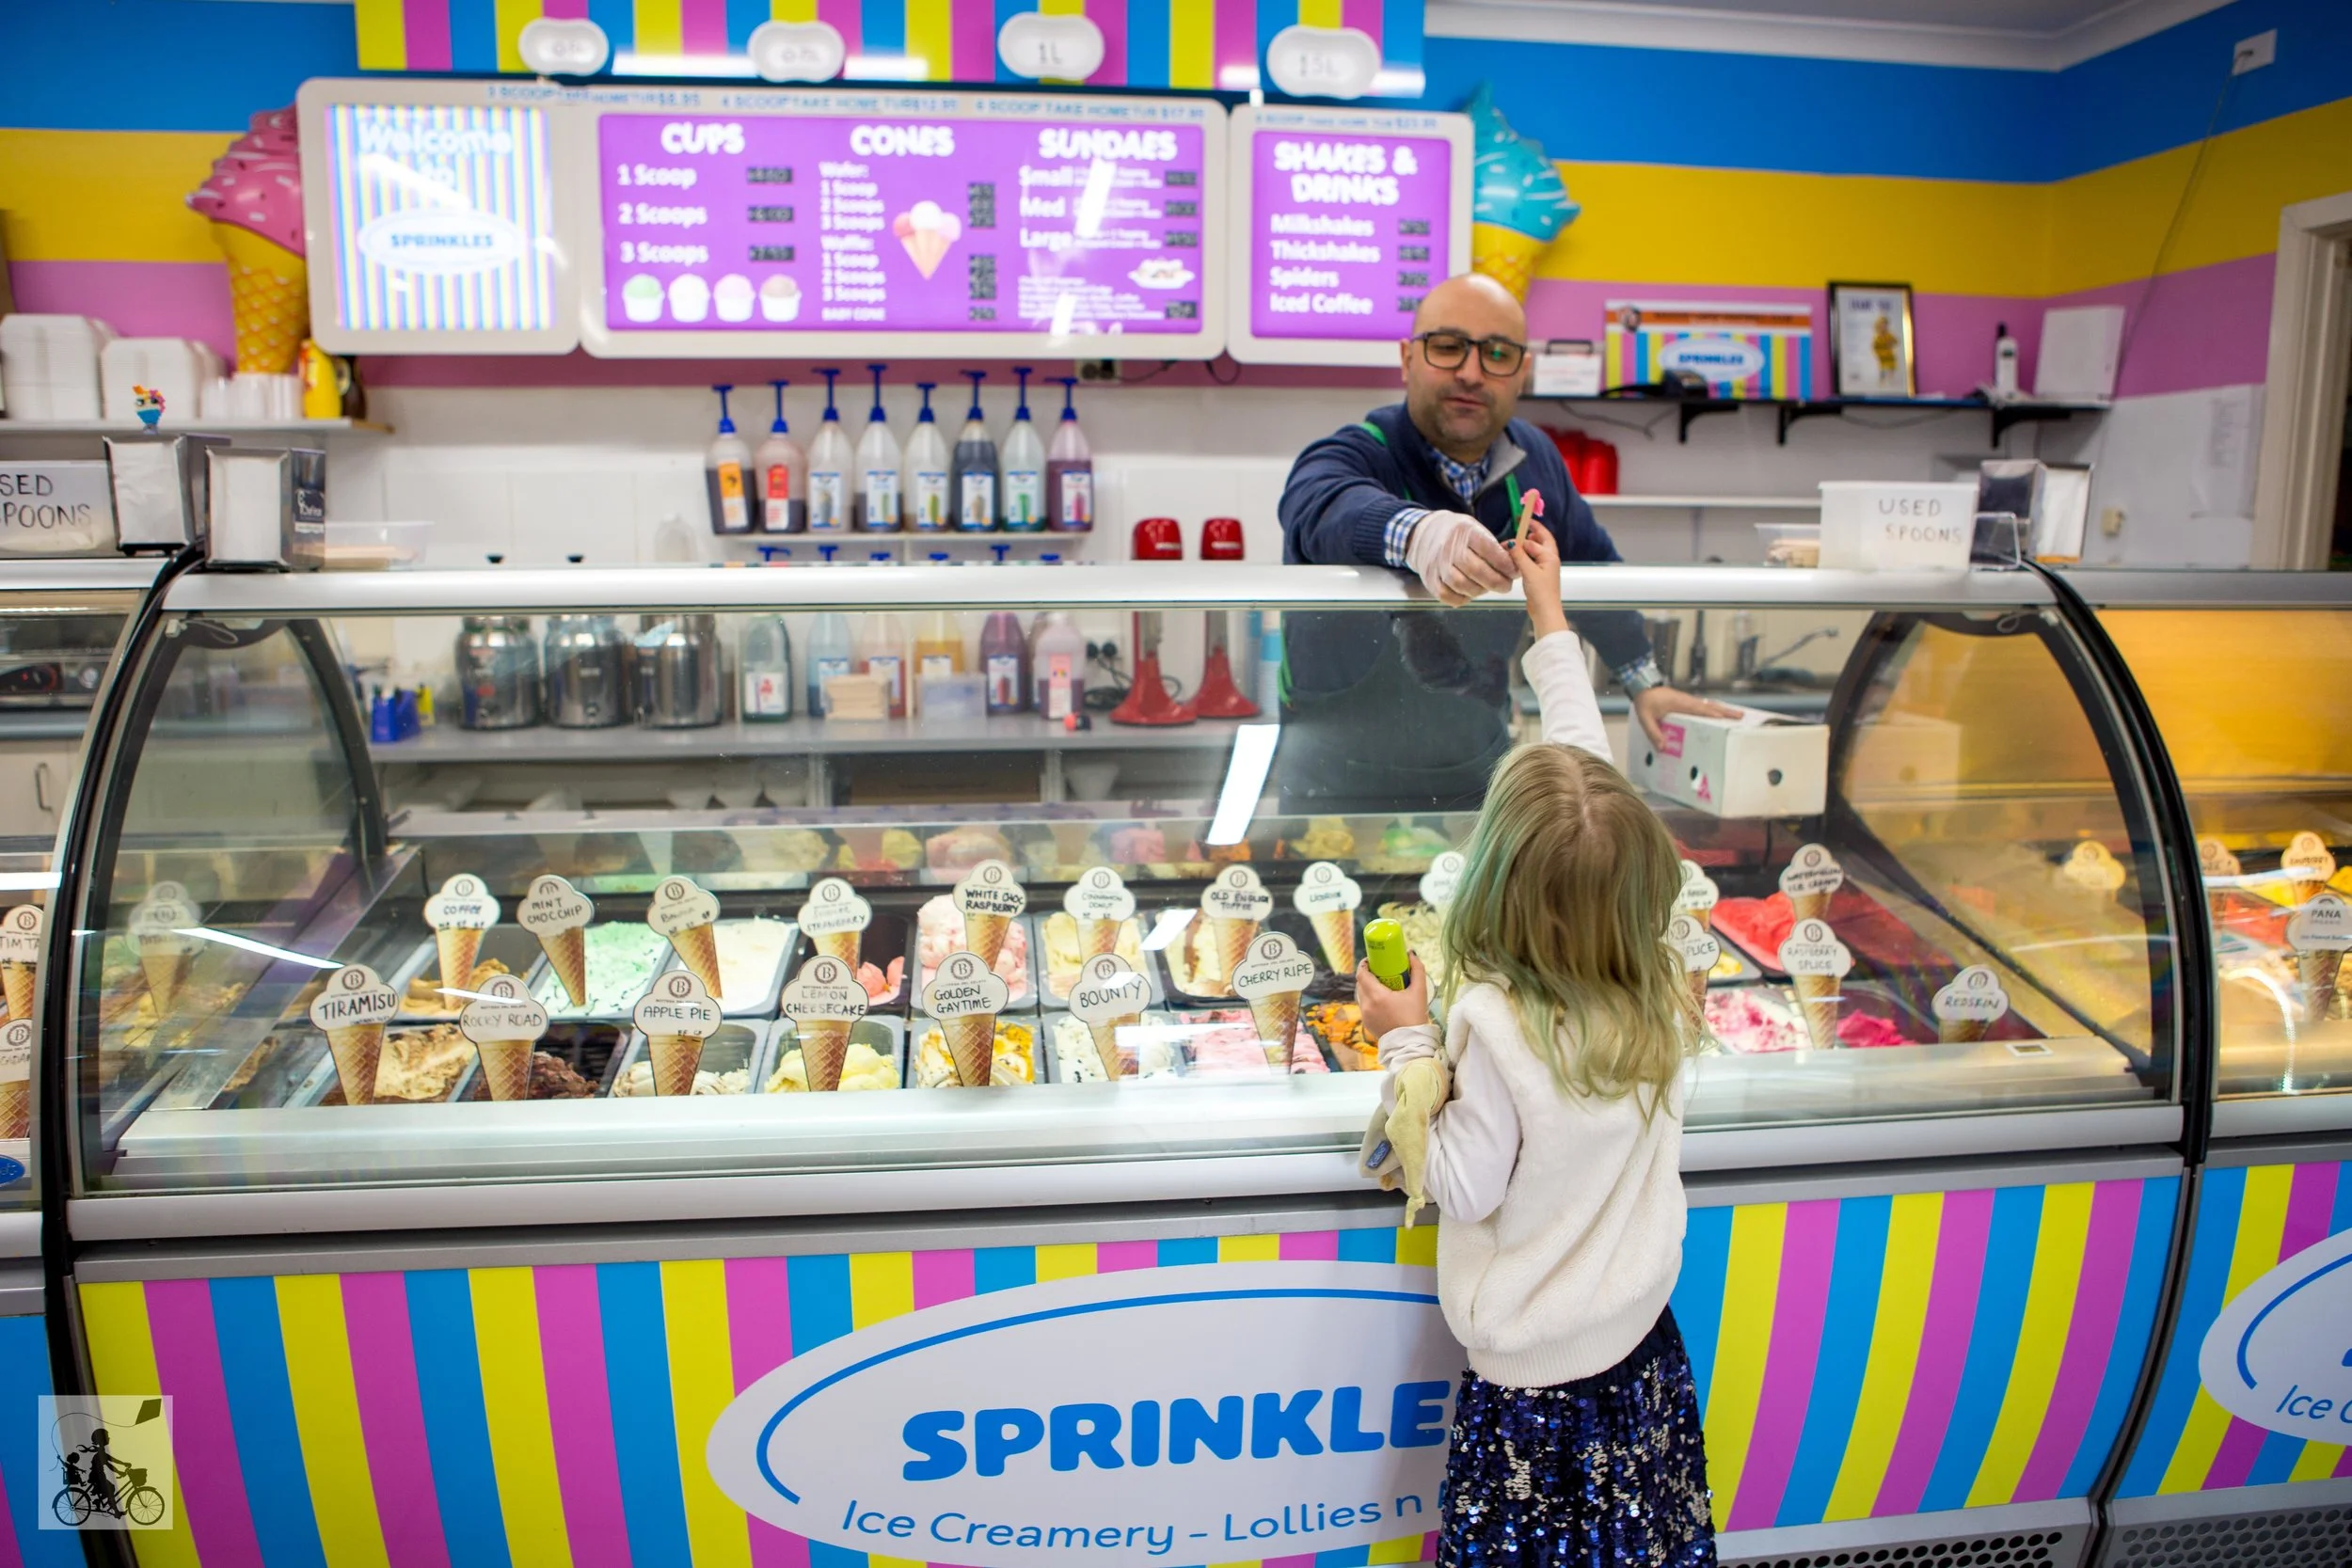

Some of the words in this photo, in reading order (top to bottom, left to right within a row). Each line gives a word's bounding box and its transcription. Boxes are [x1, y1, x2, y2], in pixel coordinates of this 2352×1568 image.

[358, 119, 513, 155] Welcome
[660, 121, 745, 155] CUPS
[850, 124, 956, 157] CONES
[1039, 128, 1178, 161] SUNDAES
[1274, 141, 1387, 174] SHAKES
[1391, 145, 1418, 175] &
[617, 164, 631, 185] 1
[634, 164, 697, 190] Scoop
[1019, 166, 1074, 186] Small
[1291, 173, 1400, 205] DRINKS
[618, 202, 633, 224] 2
[635, 202, 707, 229] Scoops
[1270, 214, 1375, 237] Milkshakes
[390, 234, 494, 247] SPRINKLES
[1269, 240, 1381, 263] Thickshakes
[620, 241, 634, 263] 3
[637, 241, 708, 267] Scoops
[1269, 266, 1339, 290] Spiders
[1270, 293, 1311, 313] Iced
[1311, 293, 1374, 315] Coffee
[1678, 353, 1744, 365] SPRINKLES
[1879, 499, 1942, 515] USED
[1884, 523, 1963, 545] SPOONS
[532, 897, 562, 910] MINT
[965, 888, 998, 900] WHITE
[1002, 893, 1024, 905] CHOC
[965, 900, 1019, 914] RASPBERRY
[1211, 892, 1229, 900] OLD
[527, 911, 557, 924] CHOC
[558, 905, 582, 919] CHIP
[2312, 909, 2342, 919] PANA
[1238, 969, 1280, 988] CHERRY
[1283, 962, 1312, 978] RIPE
[1798, 960, 1833, 971] SPLICE
[801, 990, 848, 1000] LEMON
[934, 985, 980, 1001] GOLDEN
[1079, 980, 1142, 1008] BOUNTY
[1945, 995, 1999, 1009] REDSKIN
[318, 993, 395, 1020] TIRAMISU
[644, 1006, 684, 1020] APPLE
[691, 1007, 712, 1021] PIE
[786, 1003, 866, 1017] CHEESECAKE
[936, 997, 992, 1014] GAYTIME
[463, 1014, 501, 1028] ROCKY
[508, 1013, 542, 1027] ROAD
[2276, 1385, 2333, 1420] Ice
[903, 1383, 1456, 1481] SPRINKLE
[843, 1500, 915, 1537] Ice
[930, 1513, 1173, 1555] Creamery
[1225, 1503, 1381, 1541] Lollies
[1395, 1495, 1422, 1517] n
